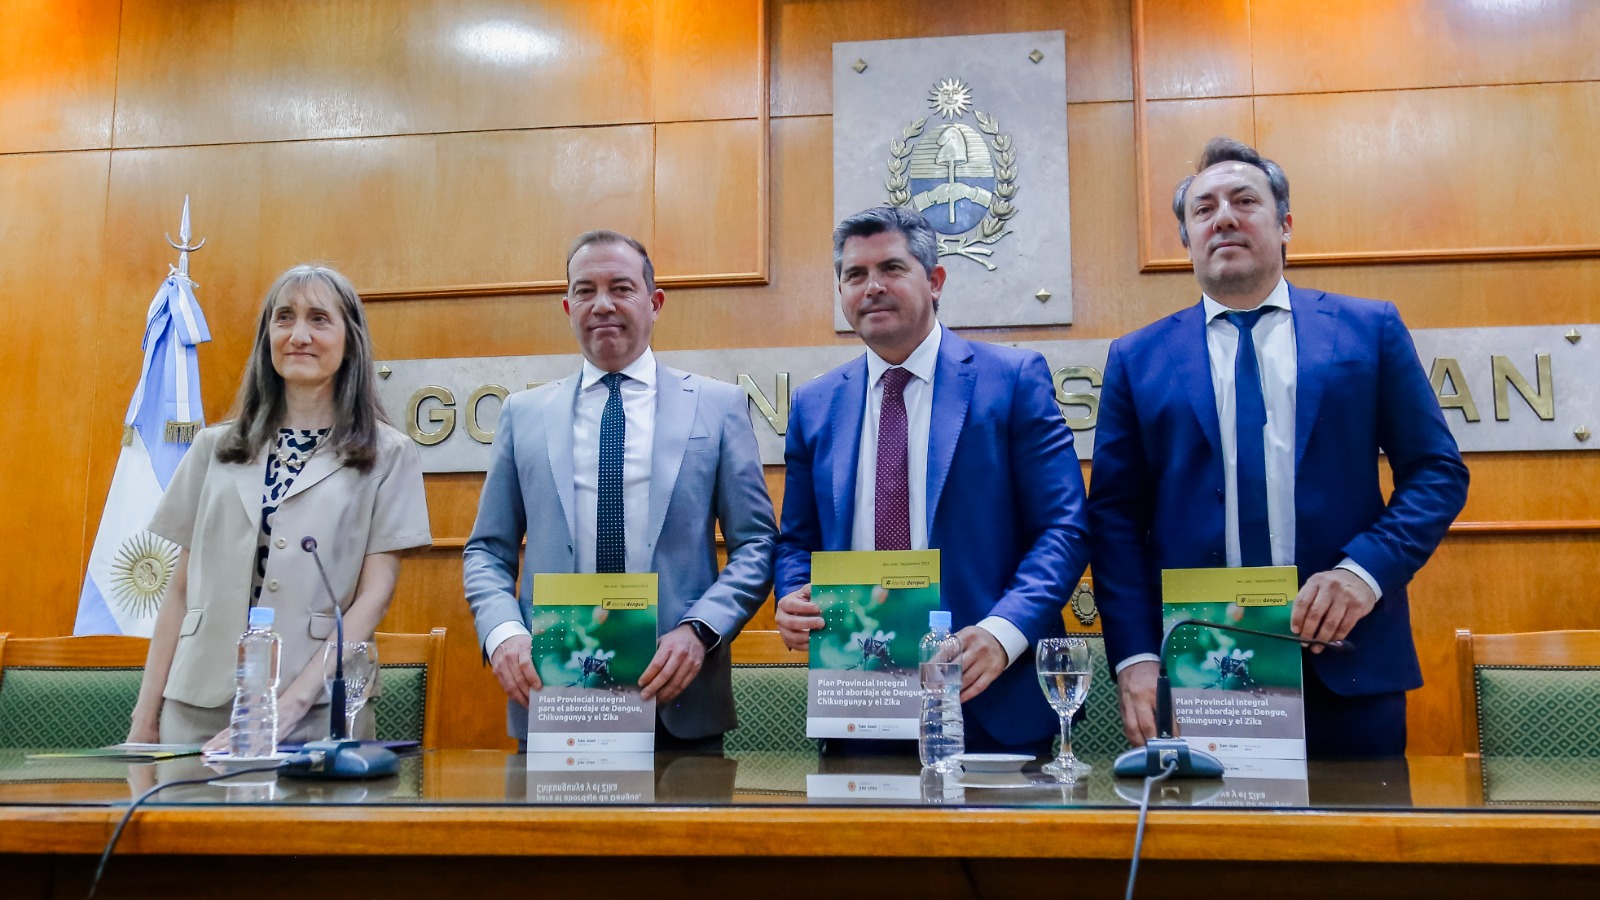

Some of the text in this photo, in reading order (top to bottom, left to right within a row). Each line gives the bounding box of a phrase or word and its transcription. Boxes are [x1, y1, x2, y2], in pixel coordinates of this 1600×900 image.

[1427, 353, 1555, 423] AN
[876, 680, 908, 688] Integral
[846, 688, 880, 697] abordaje
[596, 696, 626, 704] Integral
[817, 698, 866, 706] Chikungunya
[1236, 698, 1268, 707] Integral
[566, 704, 598, 713] abordaje
[612, 705, 642, 713] Dengue,
[1204, 708, 1240, 716] abordaje
[1254, 708, 1288, 717] Dengue,
[538, 714, 586, 722] Chikungunya
[1176, 717, 1226, 726] Chikungunya
